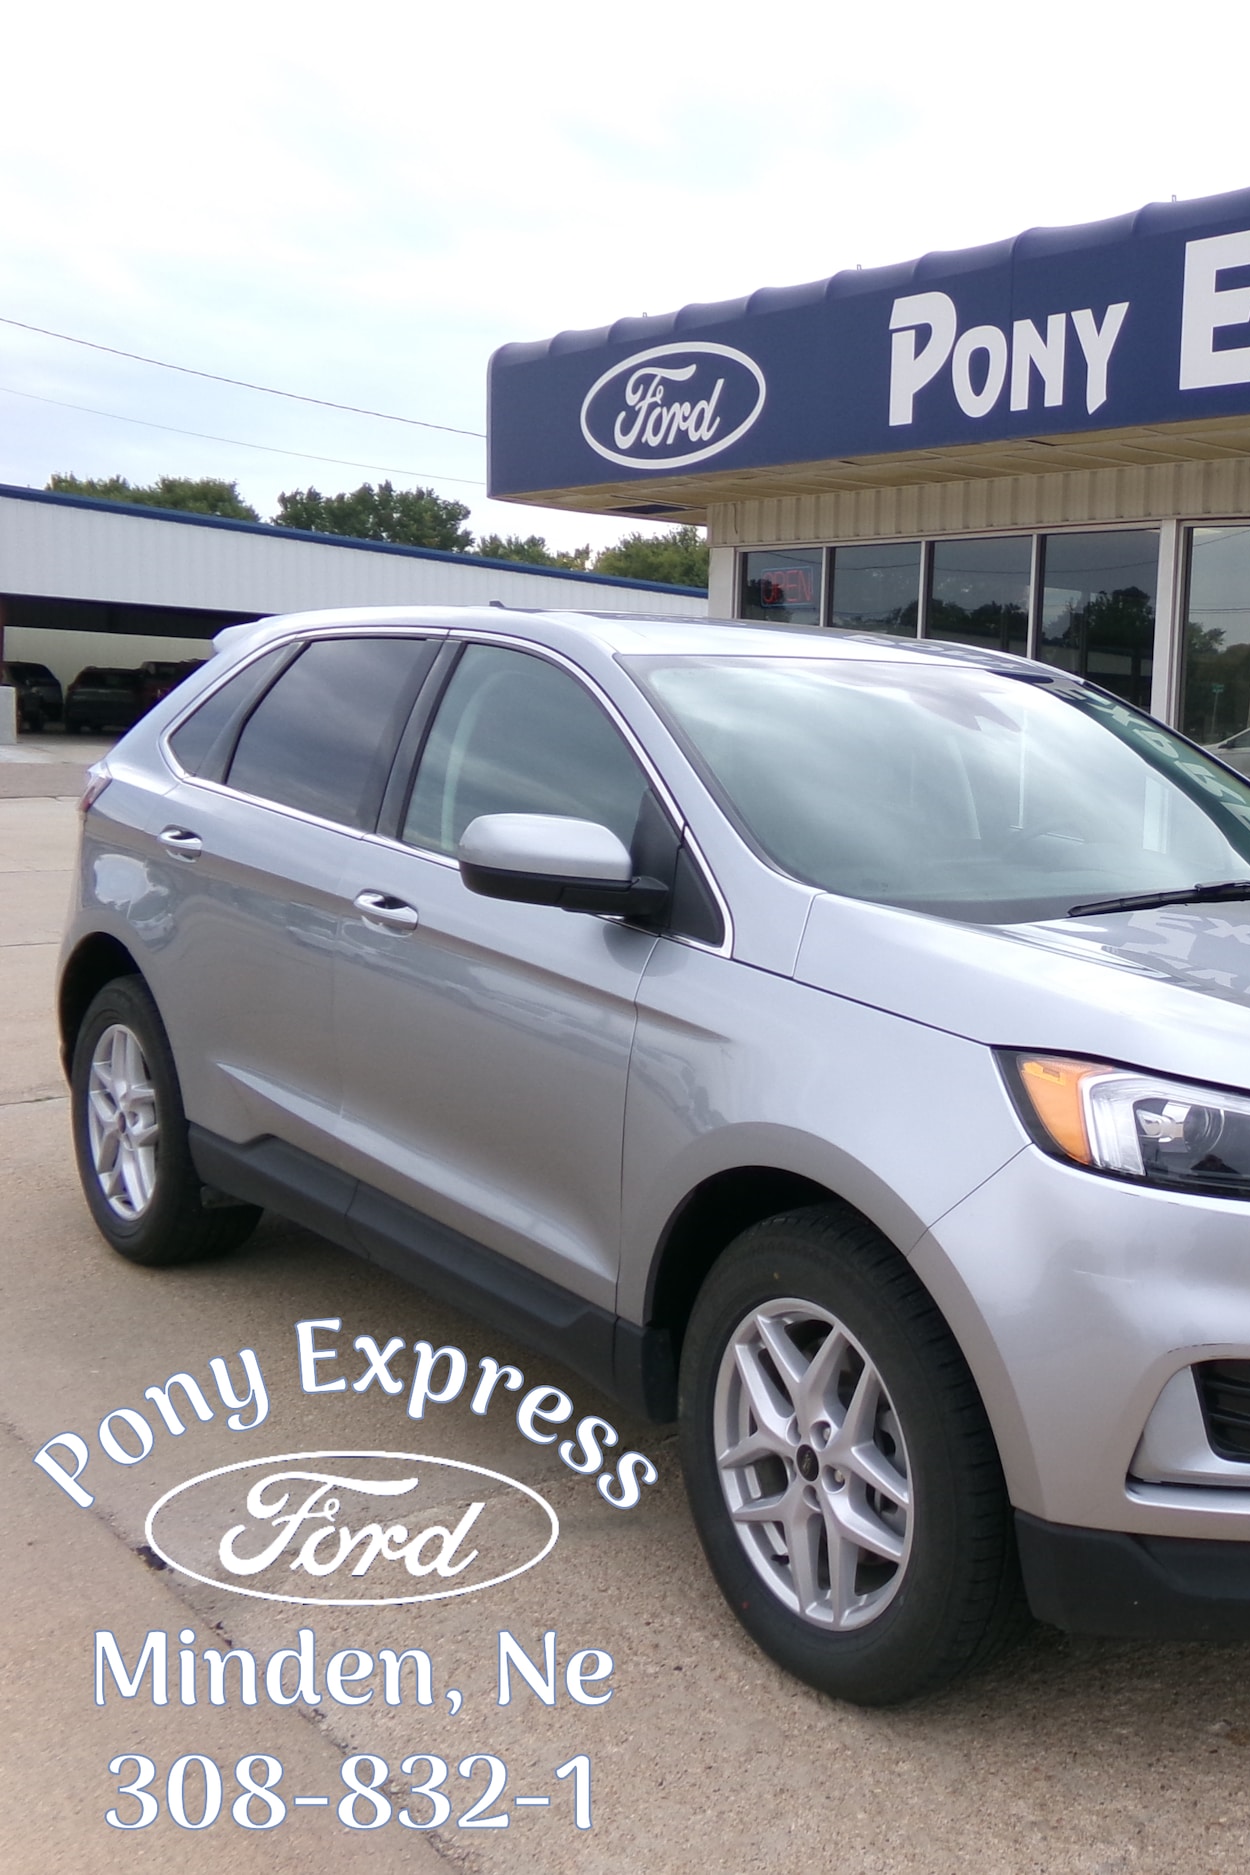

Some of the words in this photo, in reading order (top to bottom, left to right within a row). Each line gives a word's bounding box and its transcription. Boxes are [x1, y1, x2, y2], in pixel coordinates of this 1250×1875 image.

[887, 291, 1129, 427] PONY
[613, 363, 725, 449] Ford
[763, 569, 814, 604] OPEN
